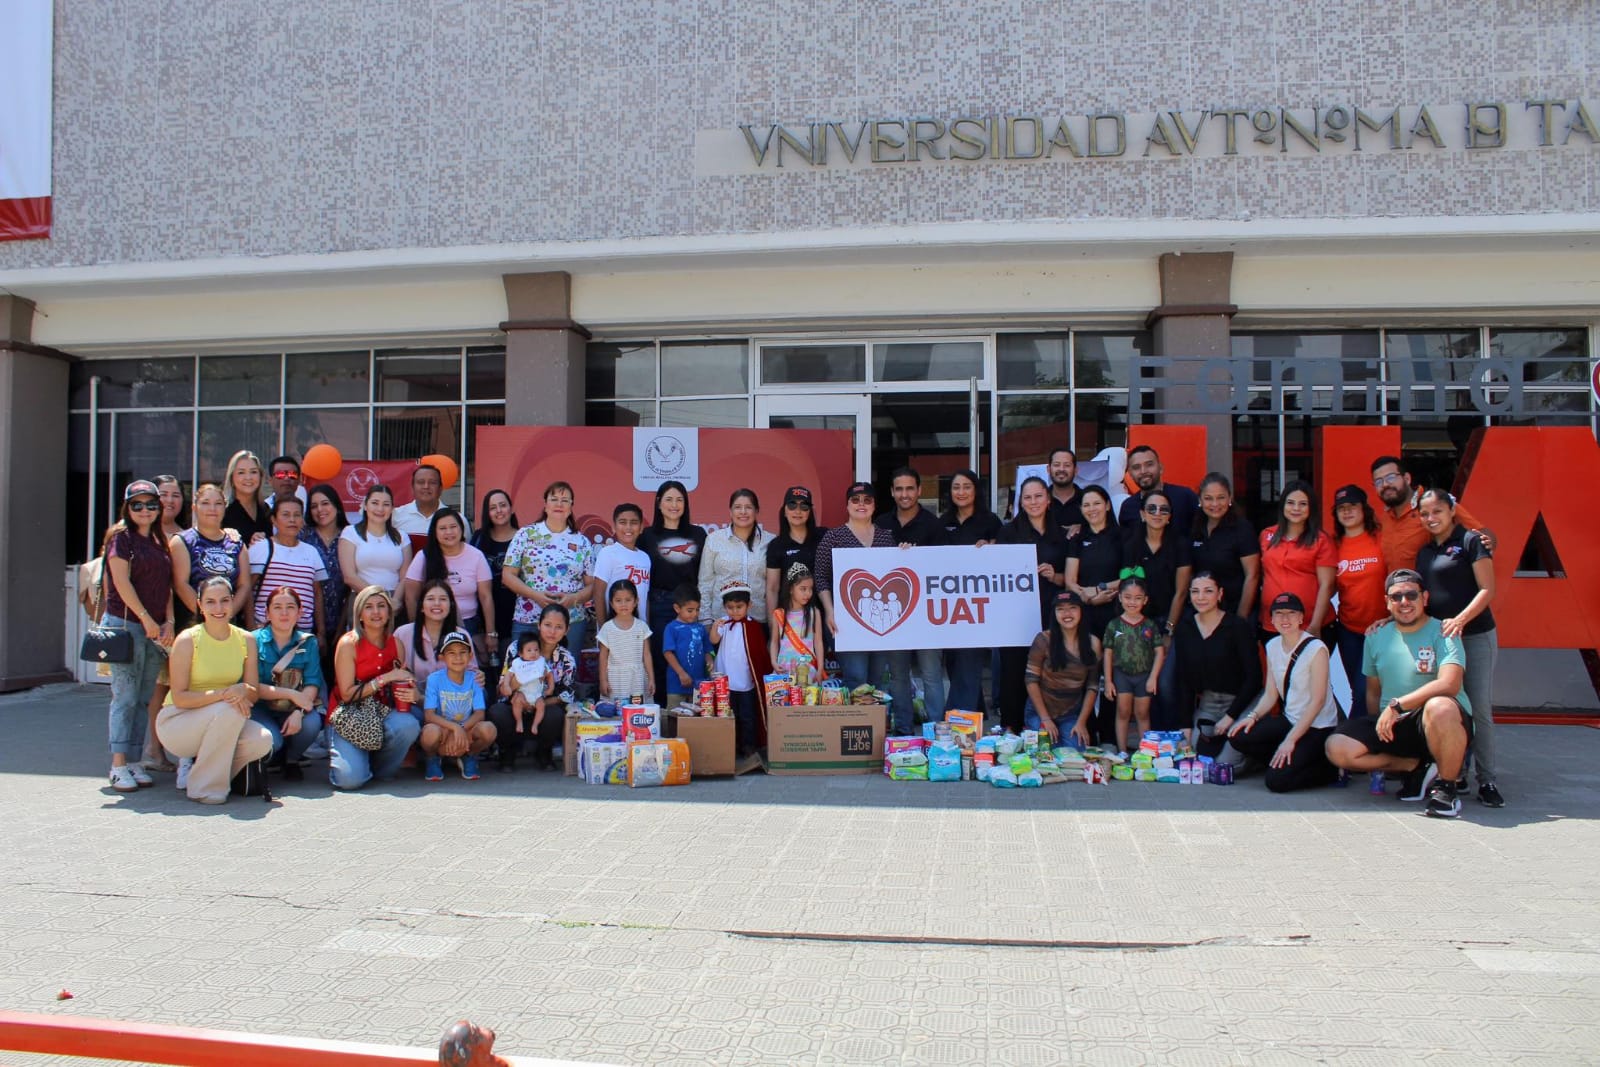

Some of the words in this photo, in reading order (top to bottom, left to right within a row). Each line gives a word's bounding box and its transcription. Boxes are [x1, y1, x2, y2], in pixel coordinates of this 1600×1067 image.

[925, 573, 1034, 595] Familia
[926, 597, 990, 626] UAT
[633, 715, 653, 725] Elite
